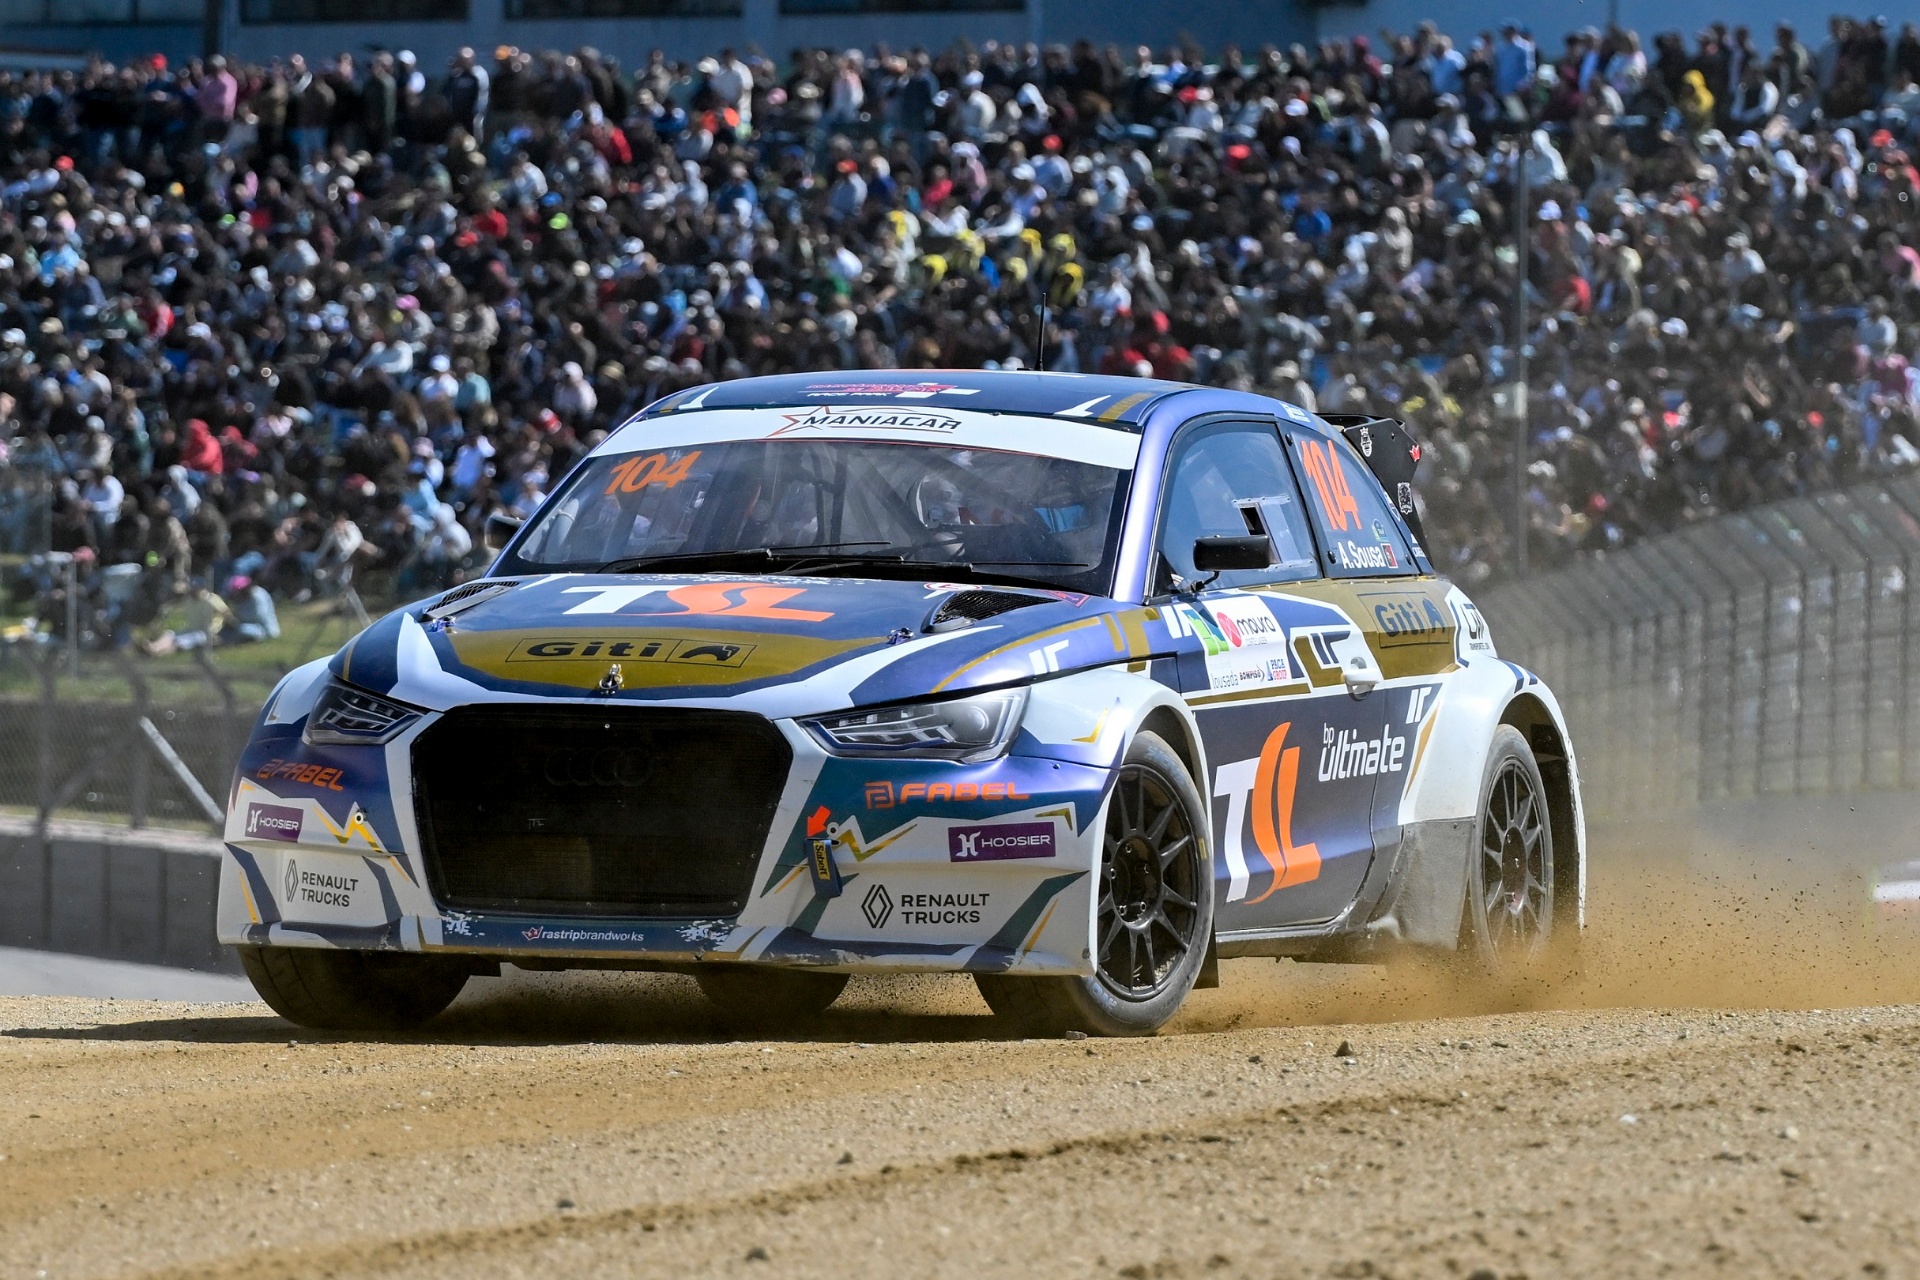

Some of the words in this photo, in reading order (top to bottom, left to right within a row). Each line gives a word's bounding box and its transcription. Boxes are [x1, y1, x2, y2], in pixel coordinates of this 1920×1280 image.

[803, 415, 962, 430] MANIACAR
[604, 451, 702, 495] 104
[1301, 440, 1362, 531] 104
[1337, 540, 1386, 569] A.Sousa
[560, 582, 835, 622] TSL
[1374, 601, 1426, 637] Giti
[527, 641, 662, 657] Giti
[1211, 670, 1239, 690] lousada
[1323, 722, 1335, 749] bp
[271, 762, 344, 792] FABEL
[900, 782, 1031, 803] FABEL
[259, 816, 300, 831] HOOSIER
[981, 835, 1051, 848] HOOSIER
[301, 871, 359, 891] RENAULT
[301, 888, 350, 907] TRUCKS
[901, 893, 990, 907] RENAULT
[901, 911, 981, 924] TRUCKS
